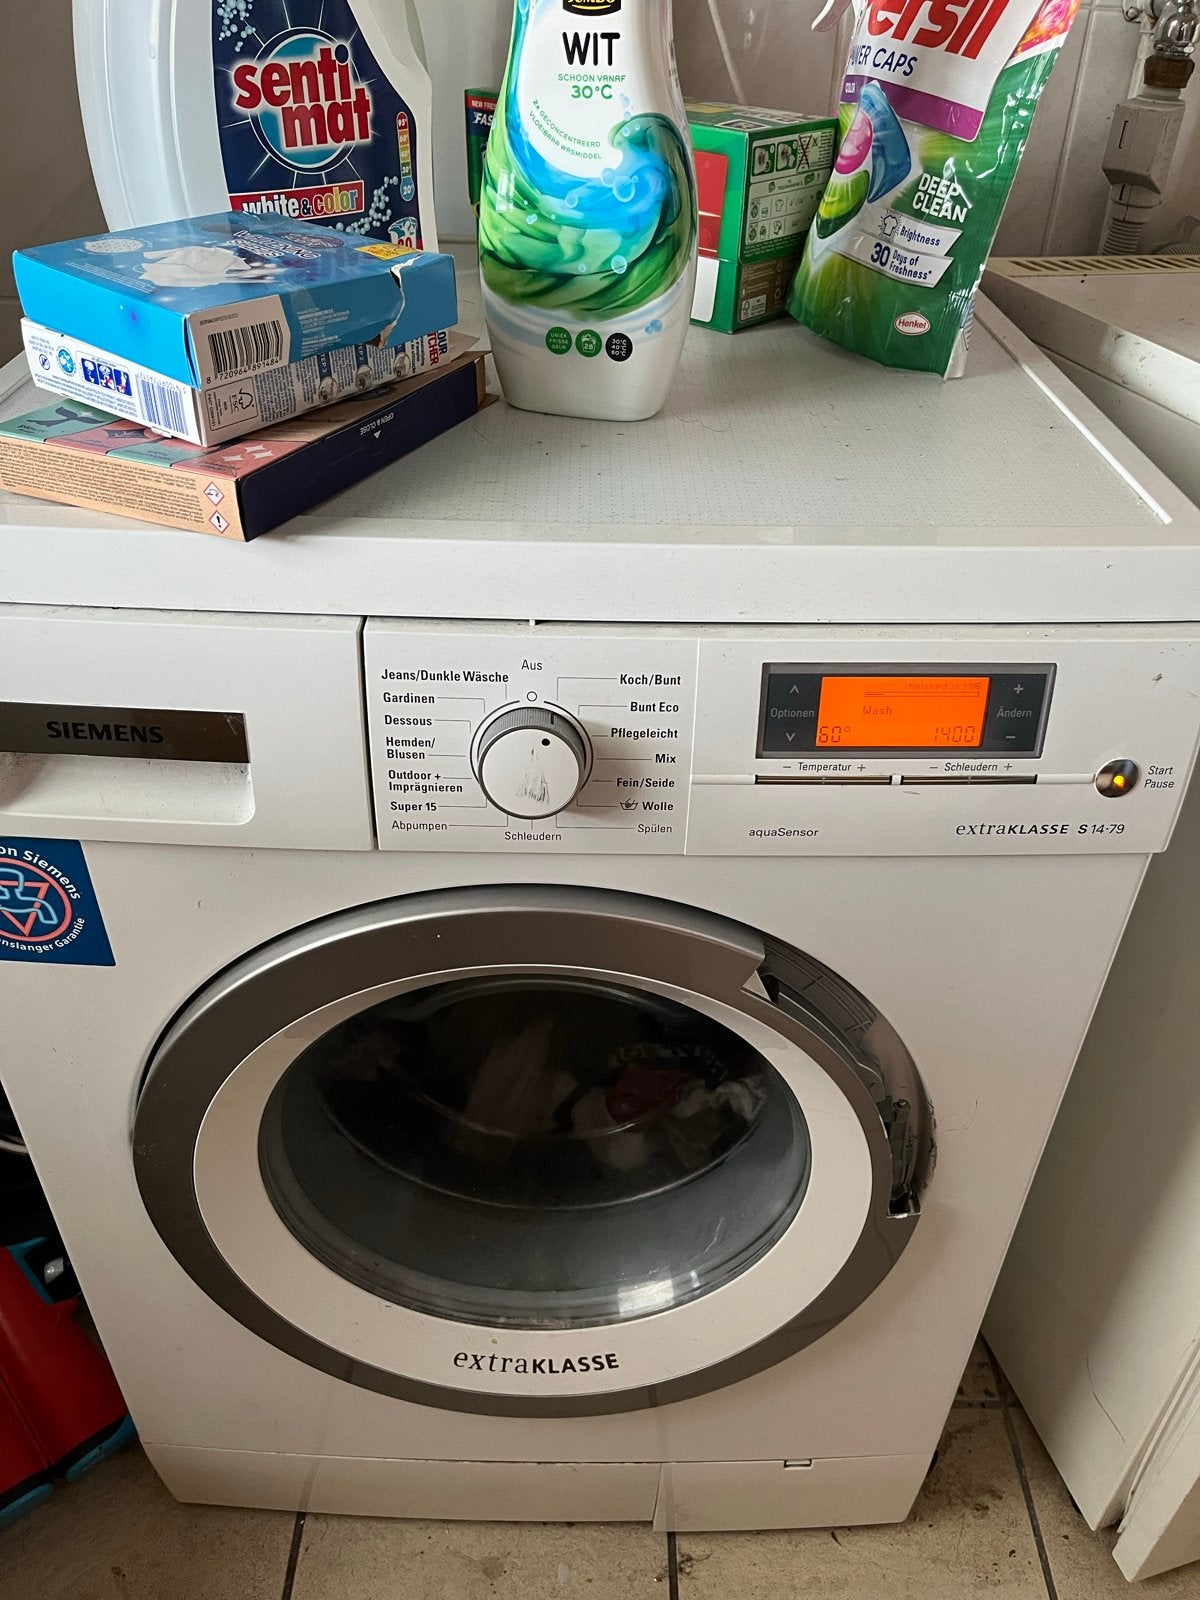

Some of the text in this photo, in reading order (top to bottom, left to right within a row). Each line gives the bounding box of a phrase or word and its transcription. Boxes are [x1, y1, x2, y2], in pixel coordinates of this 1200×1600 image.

[866, 0, 1009, 60] ersil
[562, 32, 620, 66] WIT
[873, 48, 918, 77] CAPS
[233, 43, 350, 110] senti
[558, 74, 626, 82] SCHOON VANAF
[571, 84, 612, 99] 30°C
[472, 100, 484, 108] NEW
[281, 88, 370, 148] mat
[532, 99, 600, 148] 2x GECONCENTREERD
[530, 110, 602, 160] VLOEIBAAR WASMIDDEL
[918, 172, 960, 200] DEEP
[912, 191, 968, 223] CLEAN
[900, 226, 940, 246] Brightness
[870, 242, 919, 266] 30 Days of
[898, 319, 926, 330] Henkel
[219, 368, 247, 380] 720964
[252, 358, 278, 371] 891484
[381, 412, 394, 424] OPEN
[360, 422, 376, 435] CLOSE
[521, 659, 543, 671] Aus
[381, 669, 509, 682] Jeans/Dunkle Wäsche
[620, 674, 681, 686] Koch/Bunt
[383, 692, 435, 704] Gardinen
[630, 702, 679, 713] Bunt Eco
[771, 707, 815, 719] Optionen
[863, 706, 892, 715] Wash
[997, 706, 1032, 718] Ändern
[384, 715, 432, 726] Dessous
[46, 721, 164, 744] SIEMENS
[611, 728, 678, 740] Pflegeleicht
[818, 726, 850, 743] 60°
[934, 726, 975, 742] 1400
[386, 736, 436, 748] Hemden/
[387, 749, 425, 760] Blusen
[655, 754, 676, 764] Mix
[798, 762, 851, 772] Temperatur
[944, 762, 998, 771] Schleudern
[1148, 766, 1173, 775] Start
[388, 770, 431, 780] Outdoor
[389, 782, 463, 794] Imprägnieren
[617, 778, 675, 788] Fein/Seide
[1144, 779, 1175, 789] Pause
[391, 801, 437, 812] Super 15
[642, 801, 674, 811] Wolle
[392, 820, 447, 831] Abpumpen
[637, 823, 672, 834] Spülen
[956, 822, 1069, 835] extraKLASSE
[504, 831, 562, 841] Schleudern
[749, 827, 819, 837] aquaSensor
[23, 850, 81, 900] Siemens
[55, 917, 85, 947] Garantie
[453, 1351, 620, 1374] extraKLASSE
